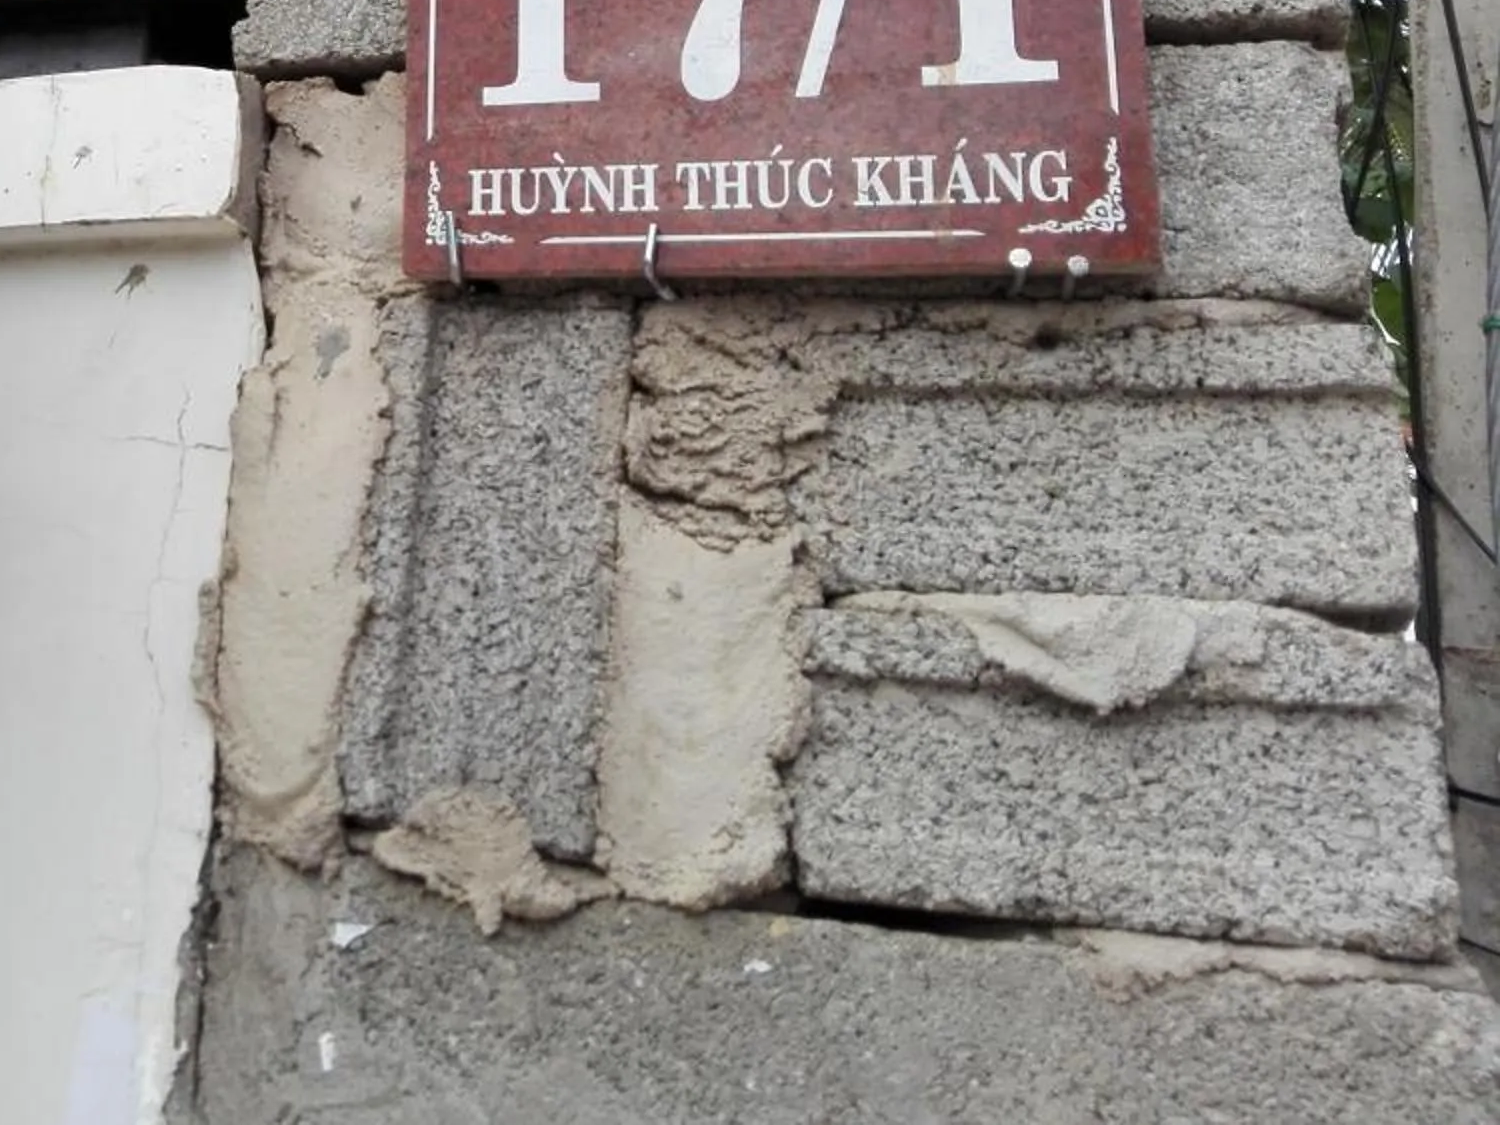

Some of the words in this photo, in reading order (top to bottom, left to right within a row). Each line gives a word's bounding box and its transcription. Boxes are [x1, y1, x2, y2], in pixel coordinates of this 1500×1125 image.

[468, 153, 659, 216] HUỲNH
[677, 145, 833, 210] THÚC
[852, 139, 1073, 206] KHÁNG
